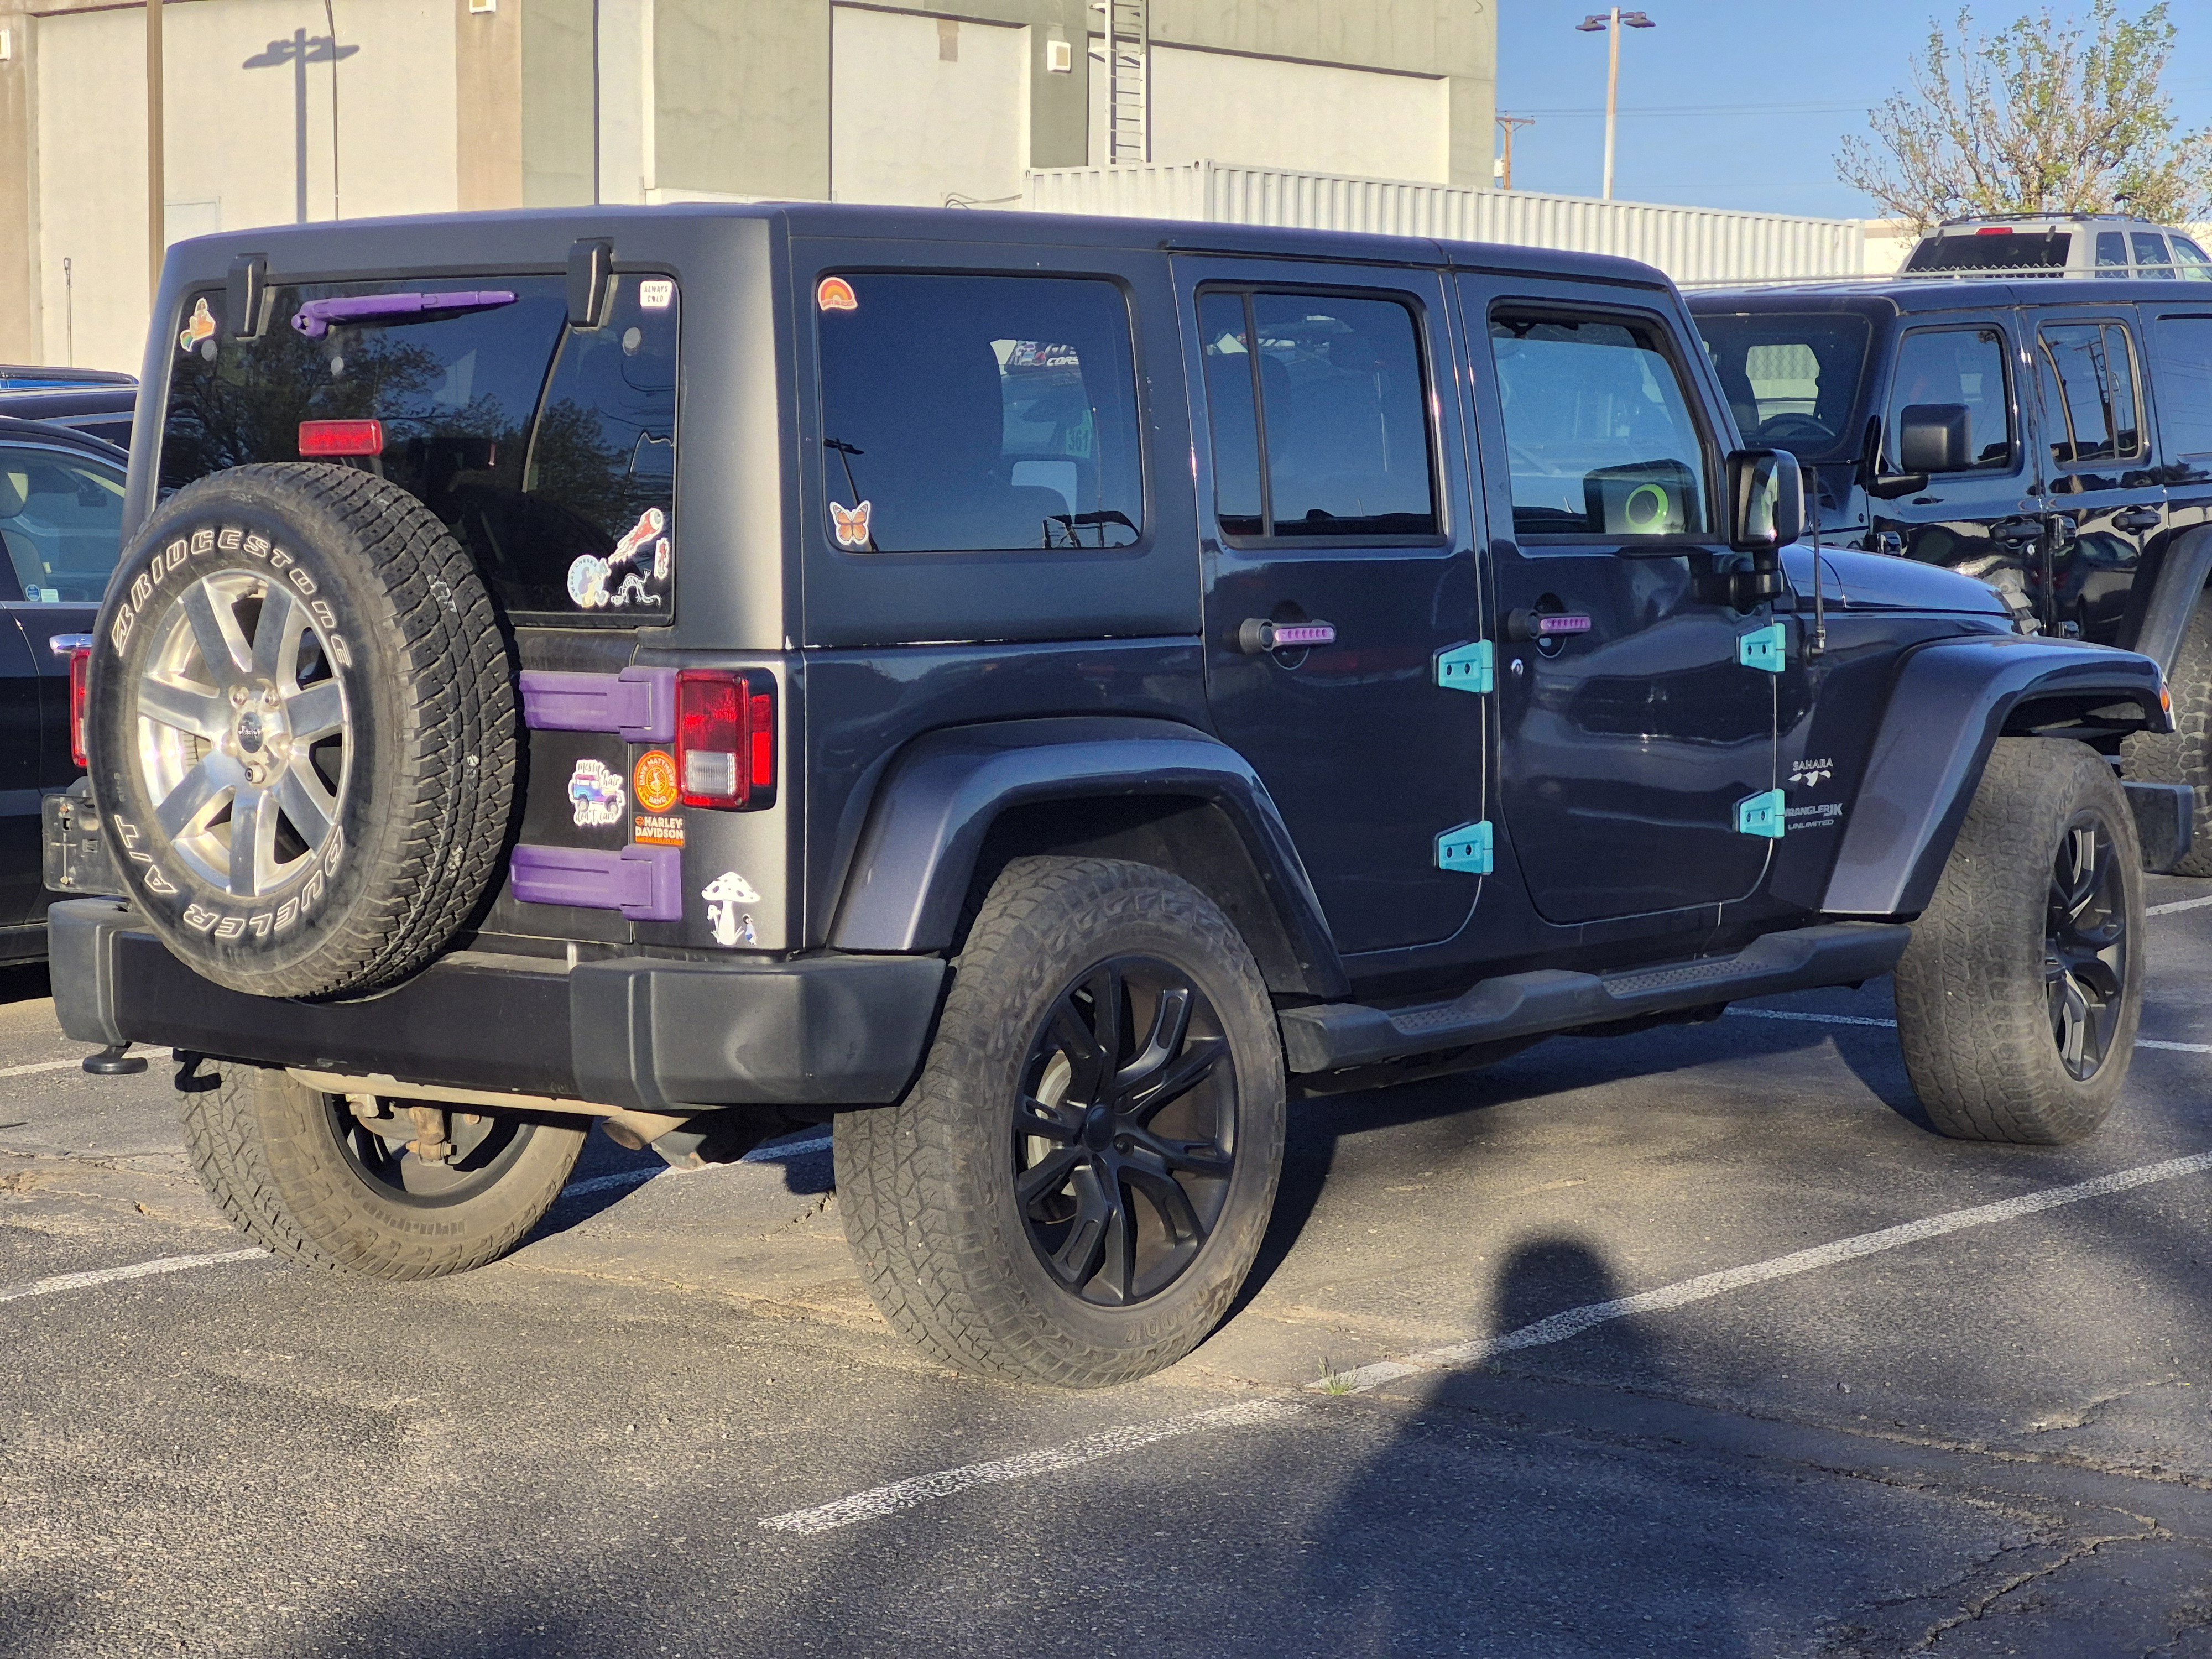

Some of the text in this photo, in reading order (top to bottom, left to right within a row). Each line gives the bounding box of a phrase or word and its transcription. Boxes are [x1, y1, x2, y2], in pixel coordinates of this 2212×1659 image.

[570, 558, 597, 598] SWEET CHEEKS
[112, 529, 352, 668] BRIDGESTONE
[639, 757, 675, 787] DAVE MATTHEWS
[1792, 757, 1834, 771] SAHARA
[602, 770, 620, 786] hair
[649, 795, 667, 804] BAND
[1787, 818, 1834, 830] UNLIMITED
[635, 826, 684, 839] DAVIDSON
[183, 825, 344, 939] DUELER
